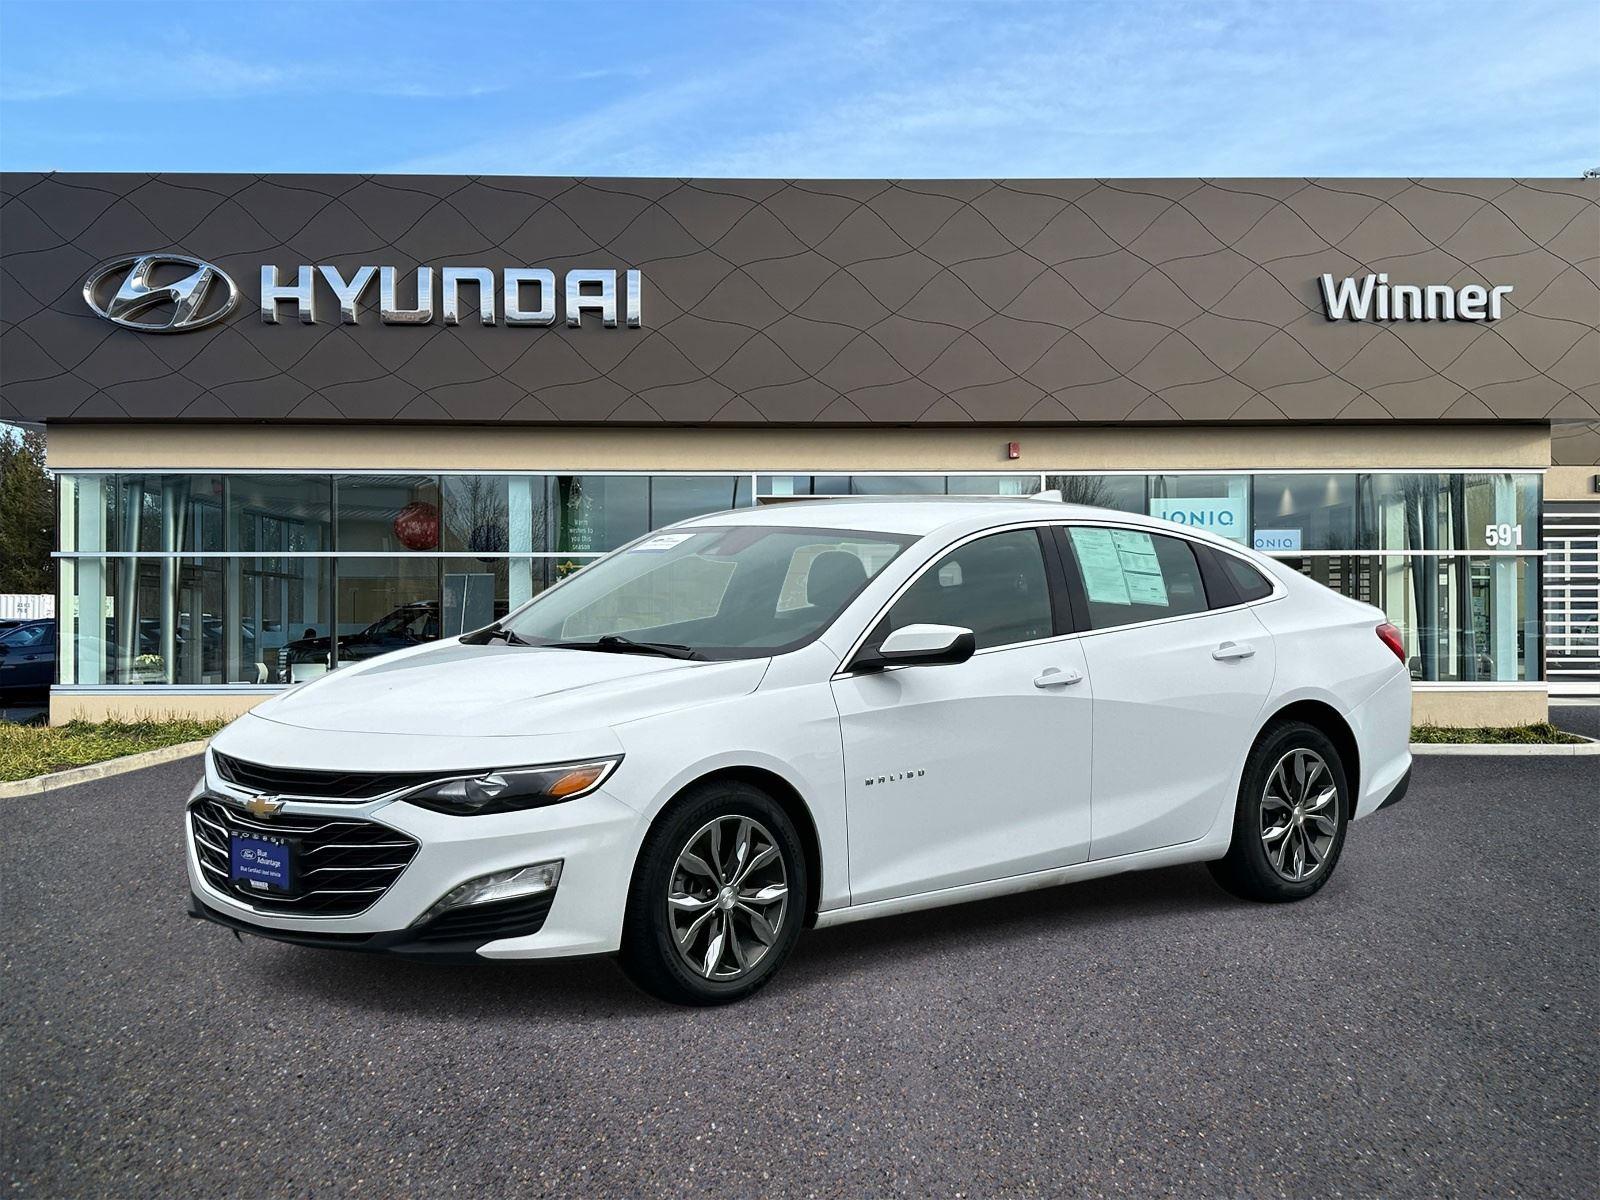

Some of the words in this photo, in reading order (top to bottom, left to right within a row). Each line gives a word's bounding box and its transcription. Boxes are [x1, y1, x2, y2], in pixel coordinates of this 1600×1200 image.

[260, 265, 642, 328] HYUNDAI
[1319, 272, 1514, 321] Winner
[1162, 511, 1234, 526] IONIQ
[1255, 538, 1293, 548] ONIQ
[1485, 523, 1522, 546] 591
[865, 769, 925, 786] MALIBU
[257, 848, 268, 857] Blue
